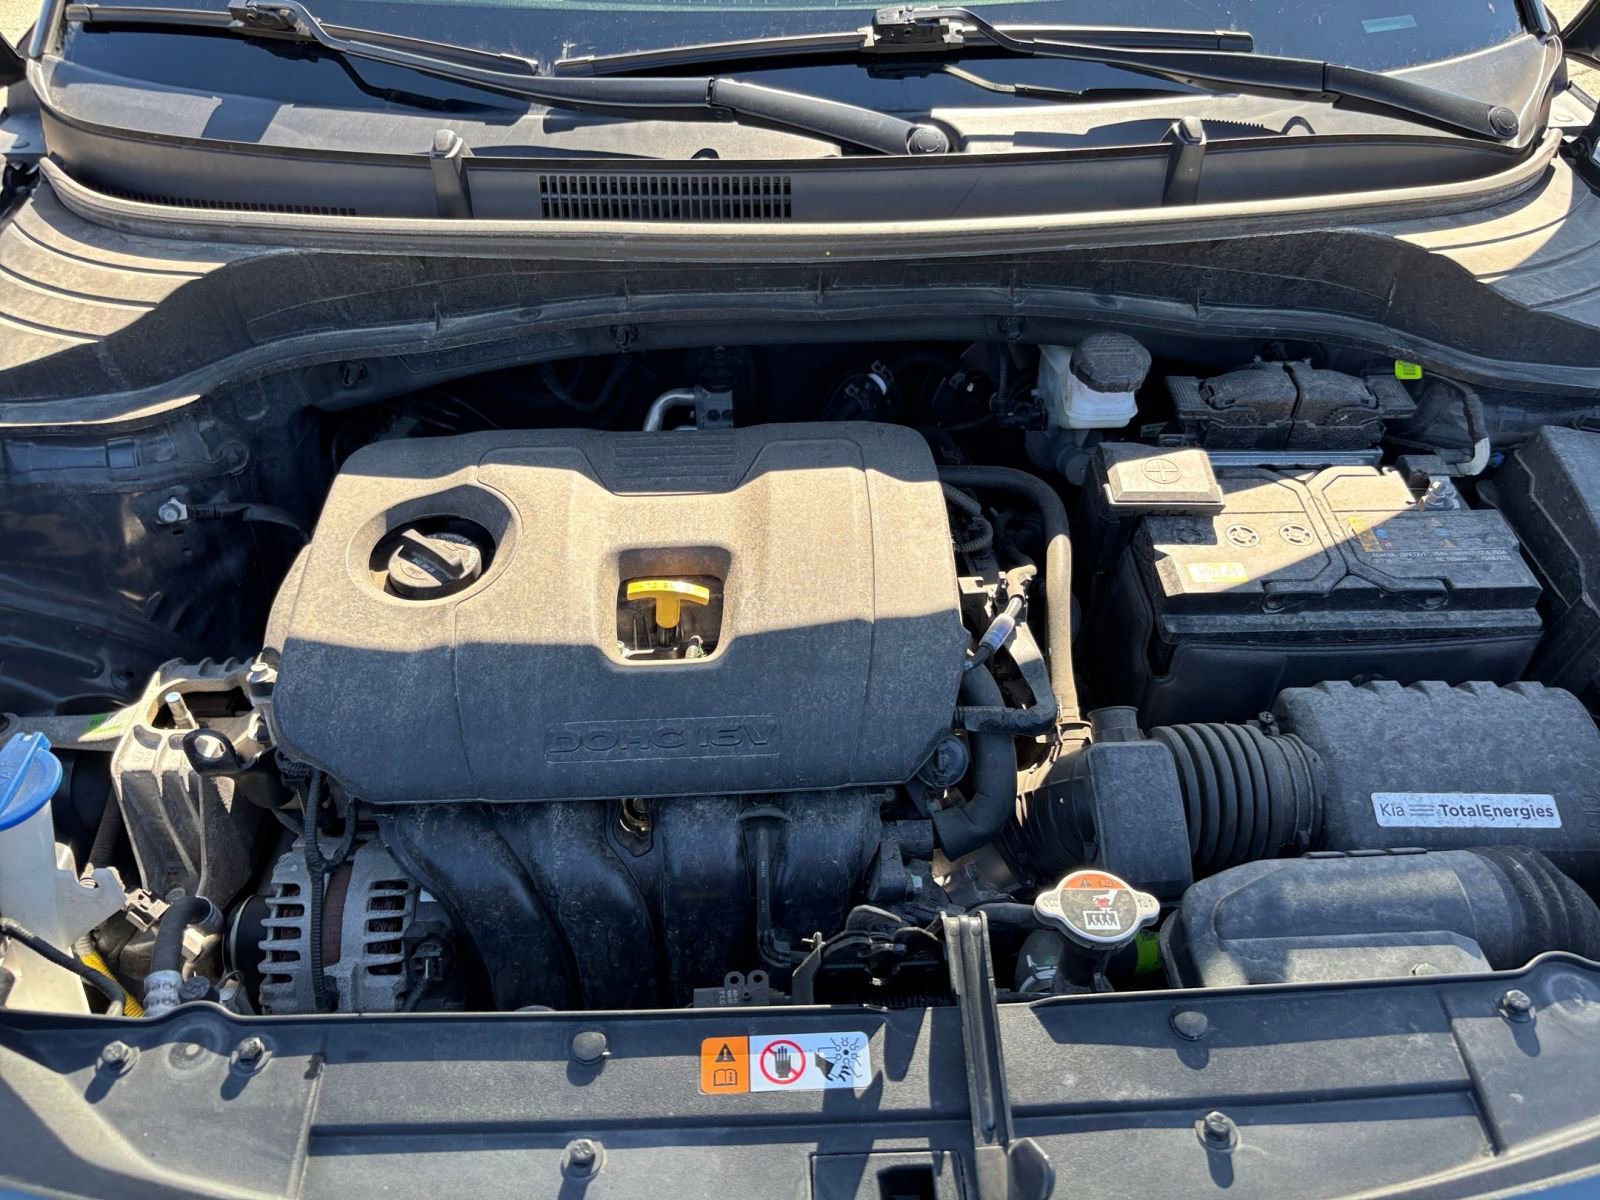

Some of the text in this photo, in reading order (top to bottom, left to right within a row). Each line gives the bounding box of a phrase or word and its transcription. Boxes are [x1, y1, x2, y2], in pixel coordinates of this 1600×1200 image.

[547, 724, 777, 753] DOHC 16V
[1379, 803, 1554, 820] Kia TotalEnergies
